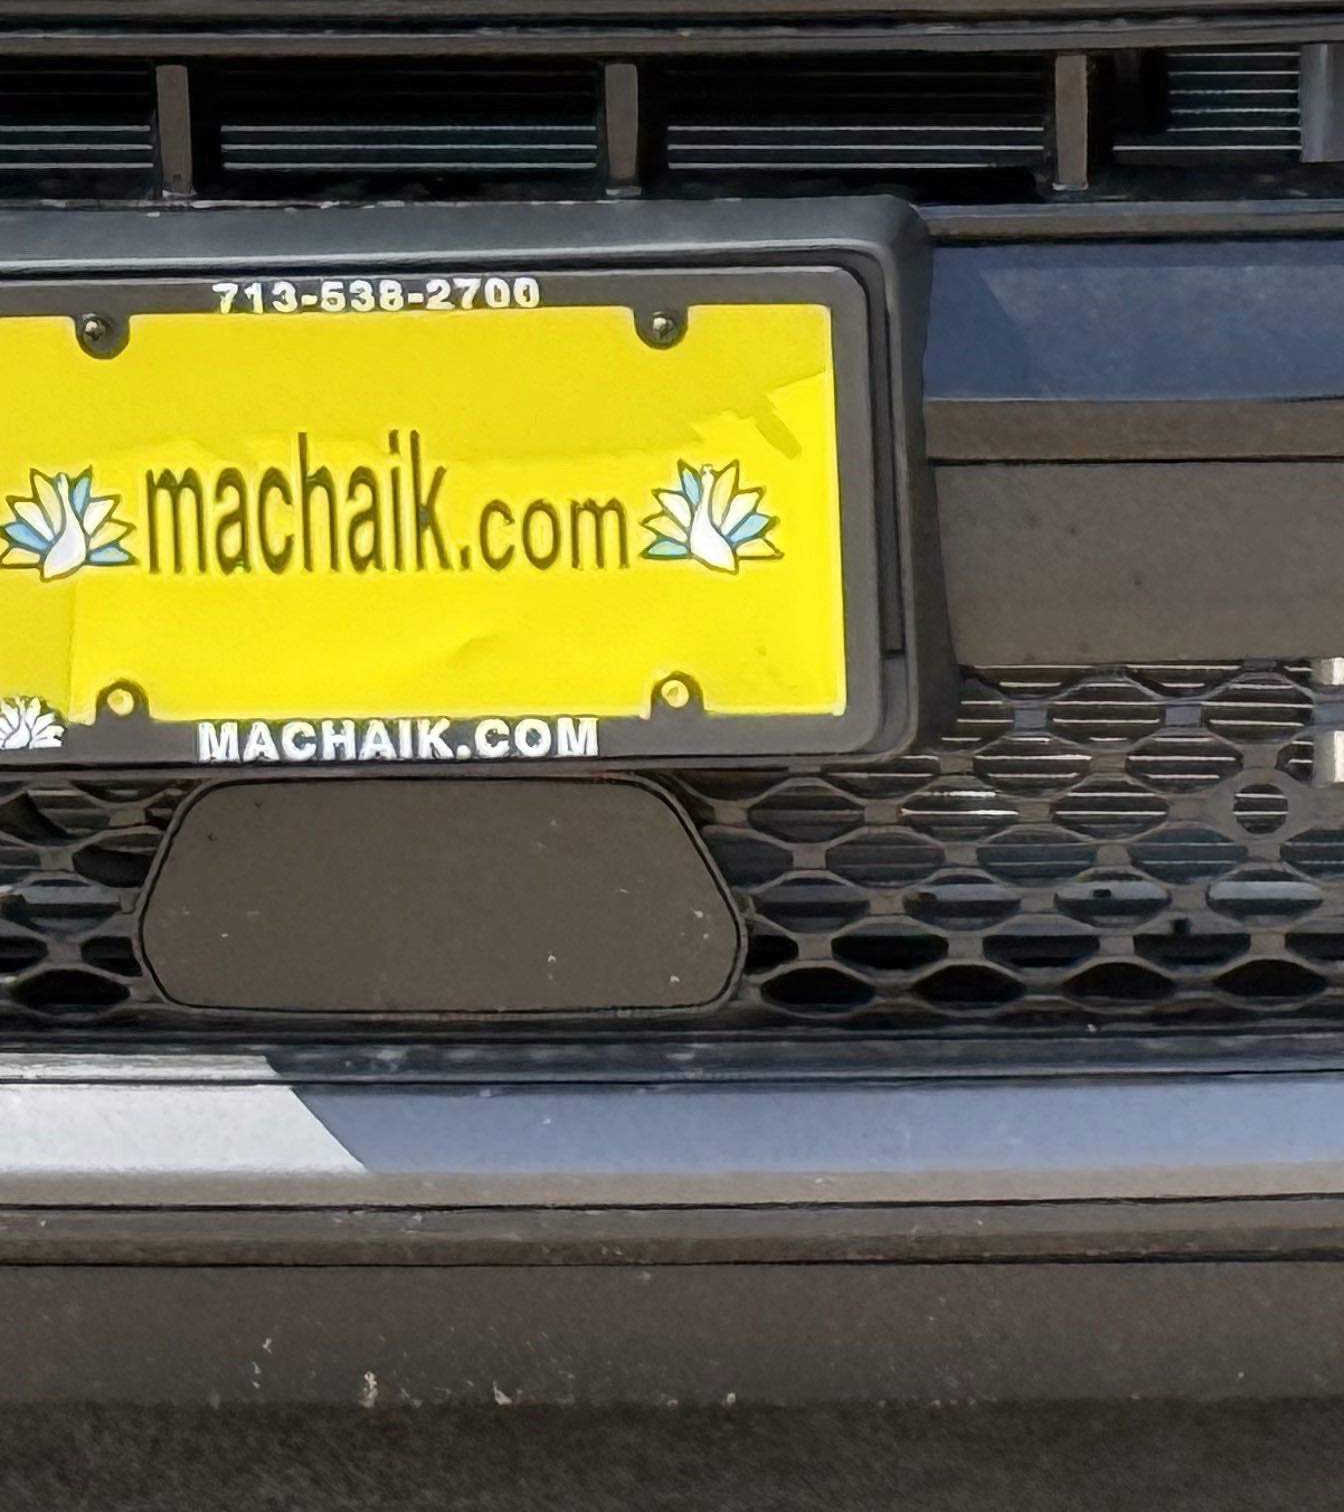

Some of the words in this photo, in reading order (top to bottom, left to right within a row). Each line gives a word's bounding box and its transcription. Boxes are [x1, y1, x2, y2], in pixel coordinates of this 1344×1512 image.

[212, 277, 540, 314] 713-538-2700
[146, 429, 630, 574] machaik.com
[198, 717, 599, 762] MACHAIK.COM
